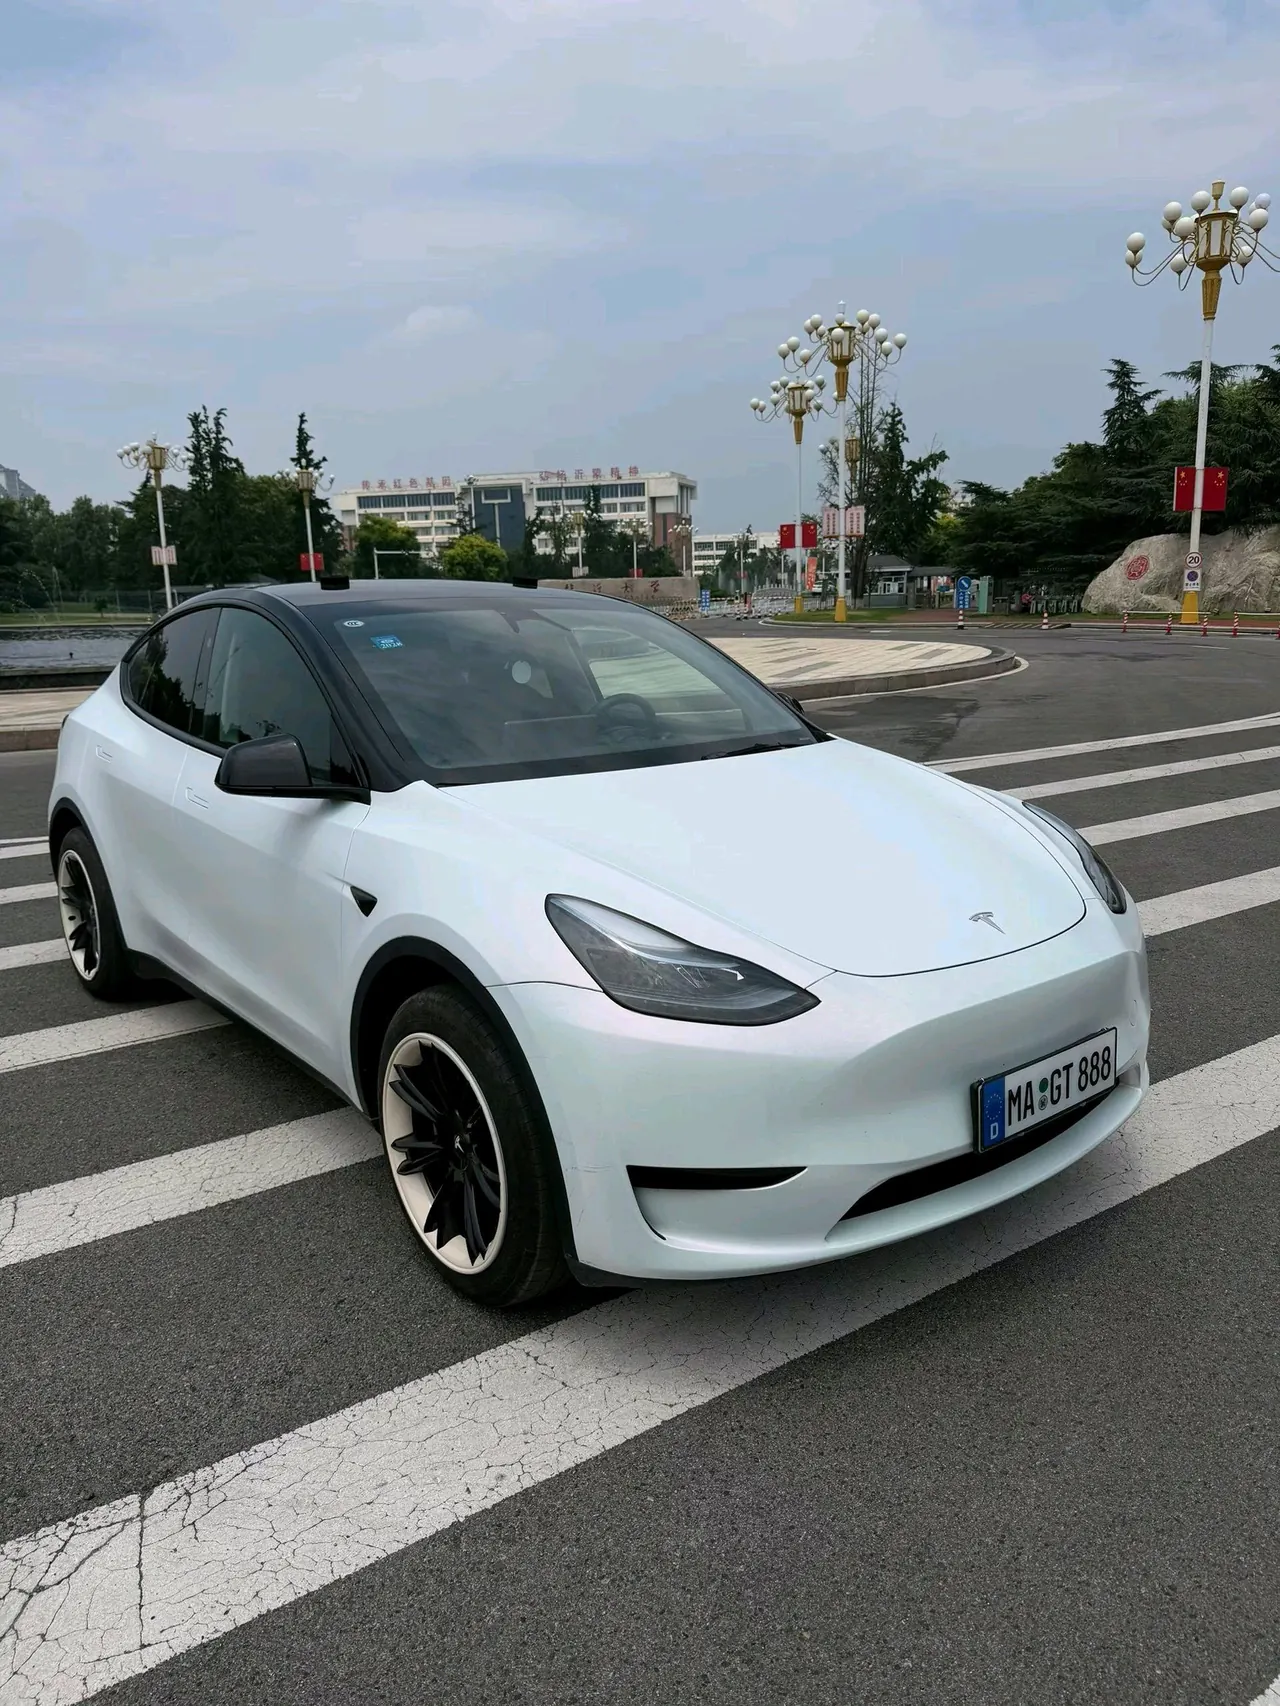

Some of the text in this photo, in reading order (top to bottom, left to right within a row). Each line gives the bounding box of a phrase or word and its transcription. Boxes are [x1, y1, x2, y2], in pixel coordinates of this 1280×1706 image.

[1188, 555, 1200, 564] 20
[1007, 1045, 1111, 1127] MA GT 888
[990, 1122, 999, 1140] D
